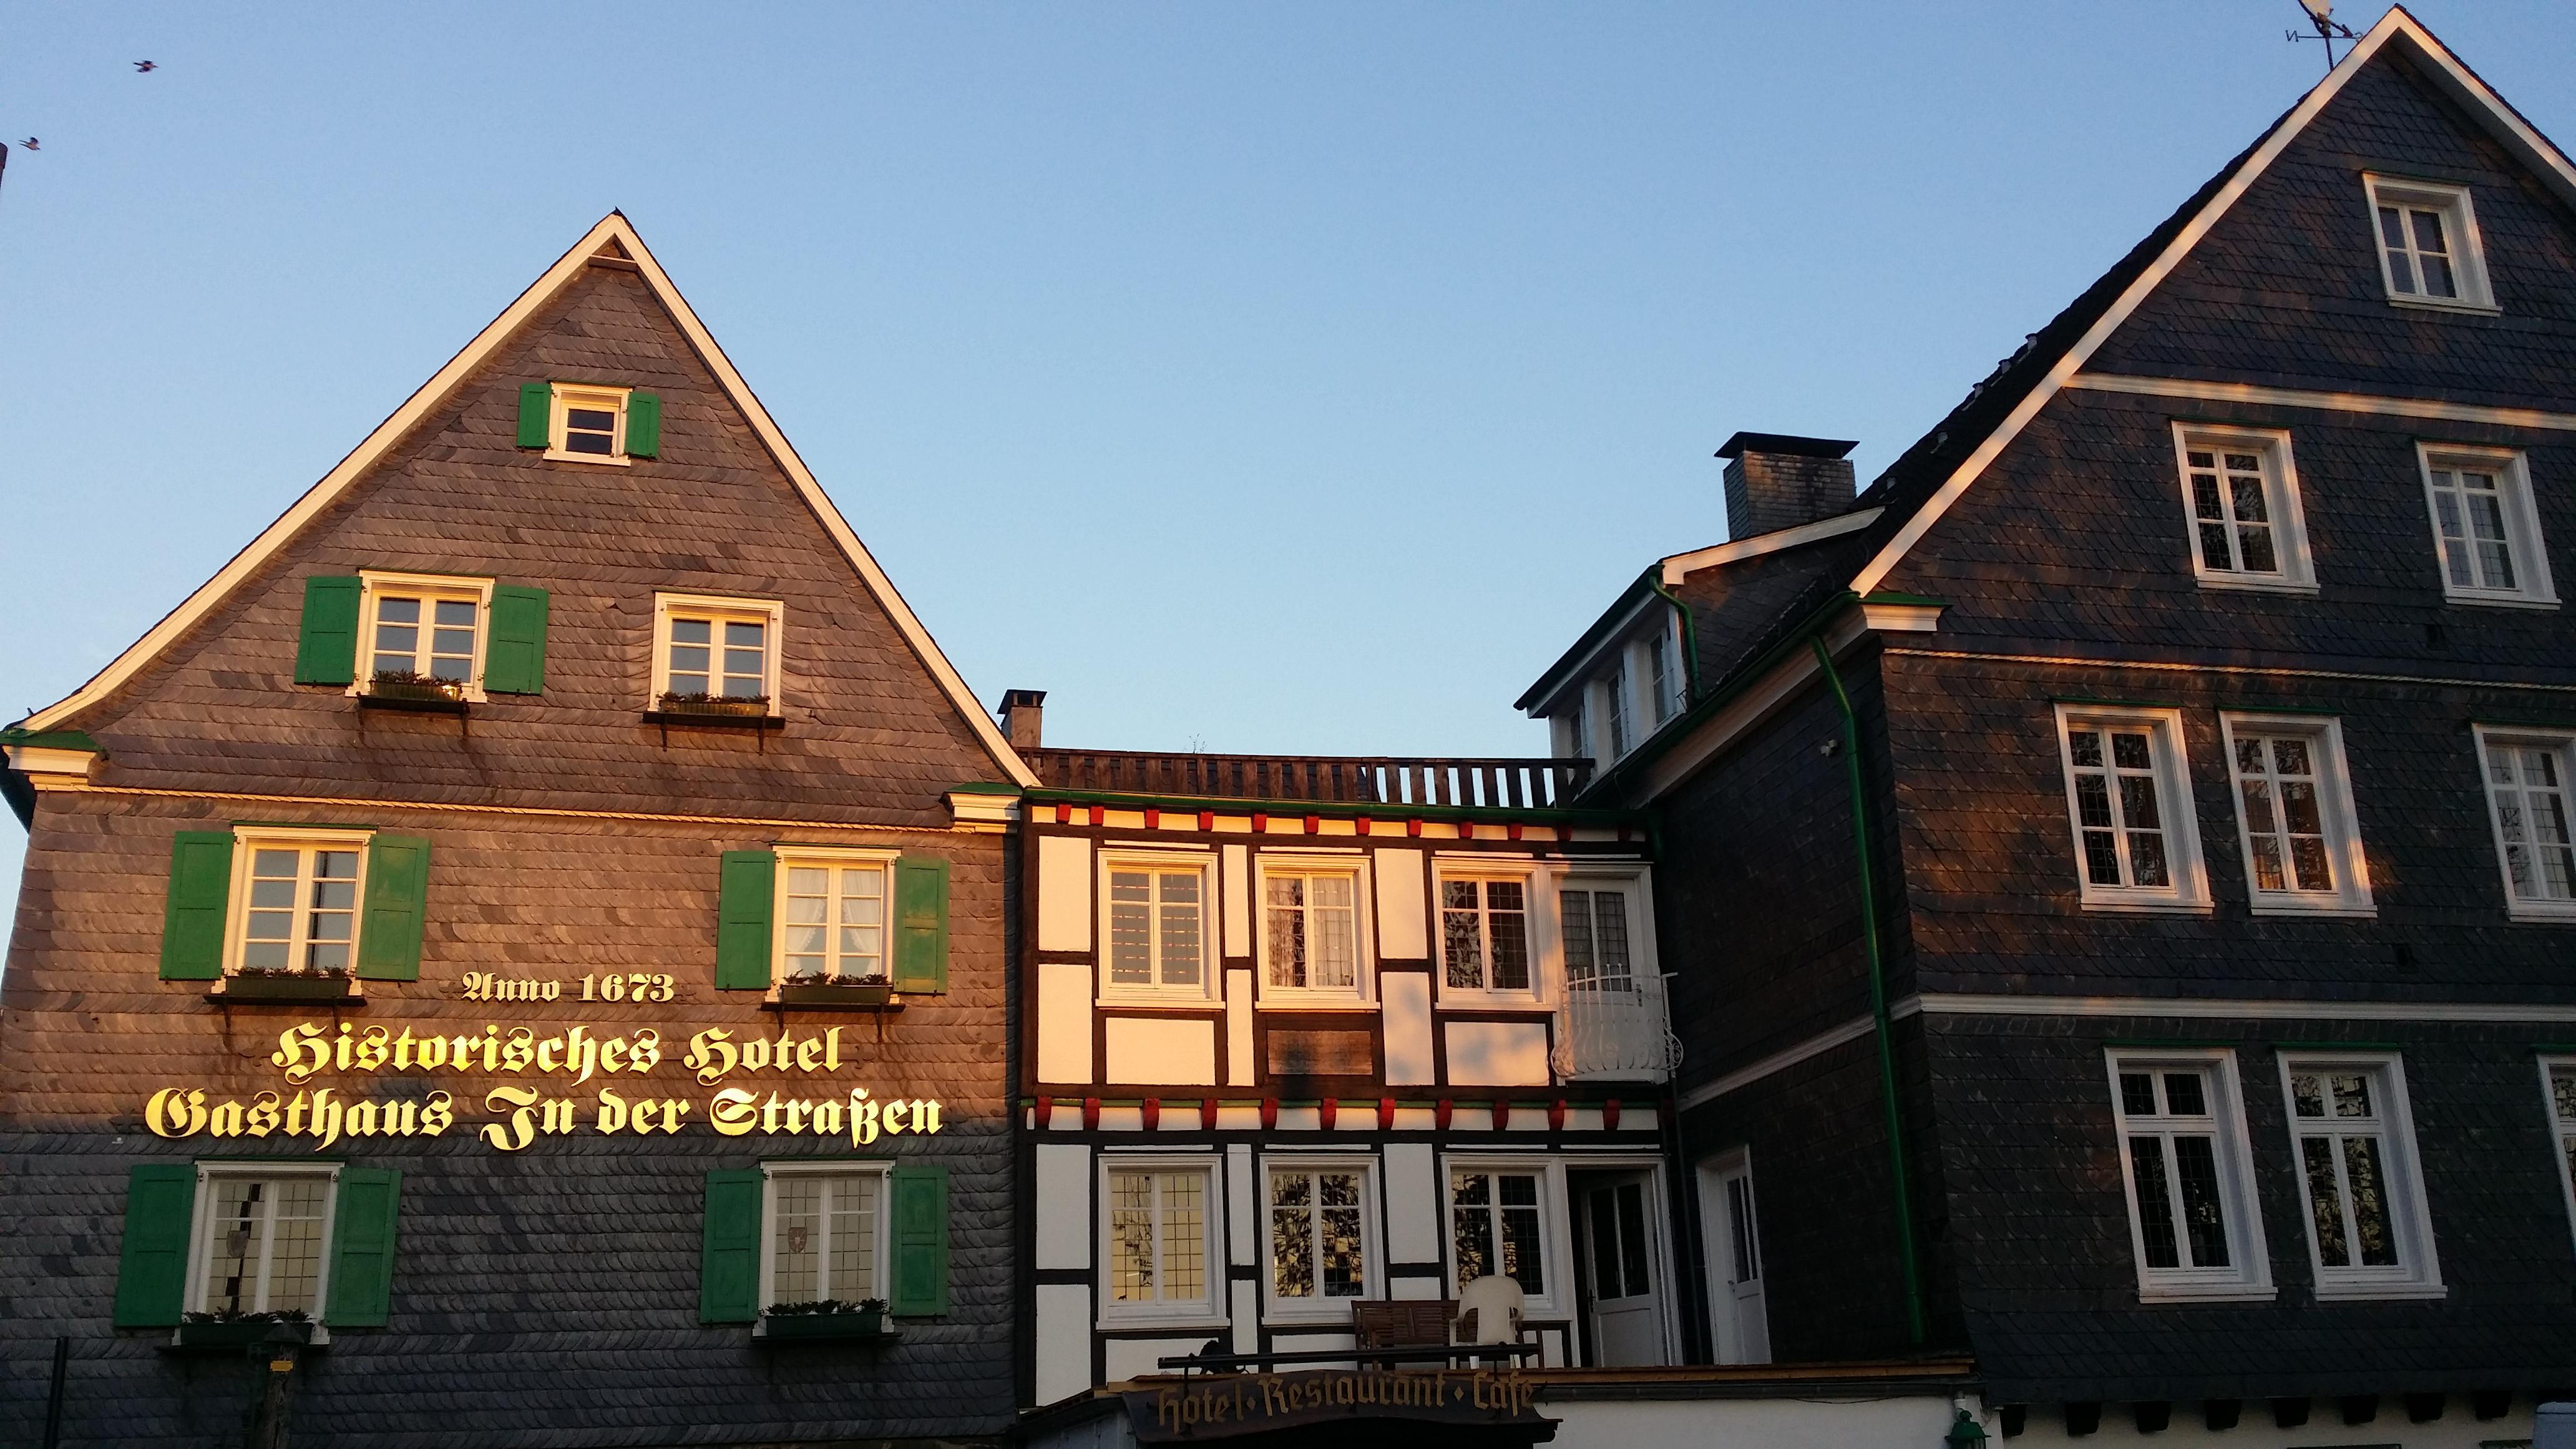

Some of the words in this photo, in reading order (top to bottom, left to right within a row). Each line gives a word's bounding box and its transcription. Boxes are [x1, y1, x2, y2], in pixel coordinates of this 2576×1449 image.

[462, 971, 560, 1002] Anno
[578, 973, 675, 1002] 1673
[271, 1022, 660, 1086] Historisches
[683, 1026, 844, 1086] Hotel
[145, 1088, 453, 1151] Gasthaus
[595, 1088, 691, 1135] der
[710, 1087, 943, 1148] Straßen
[1258, 1372, 1447, 1417] Restaurant
